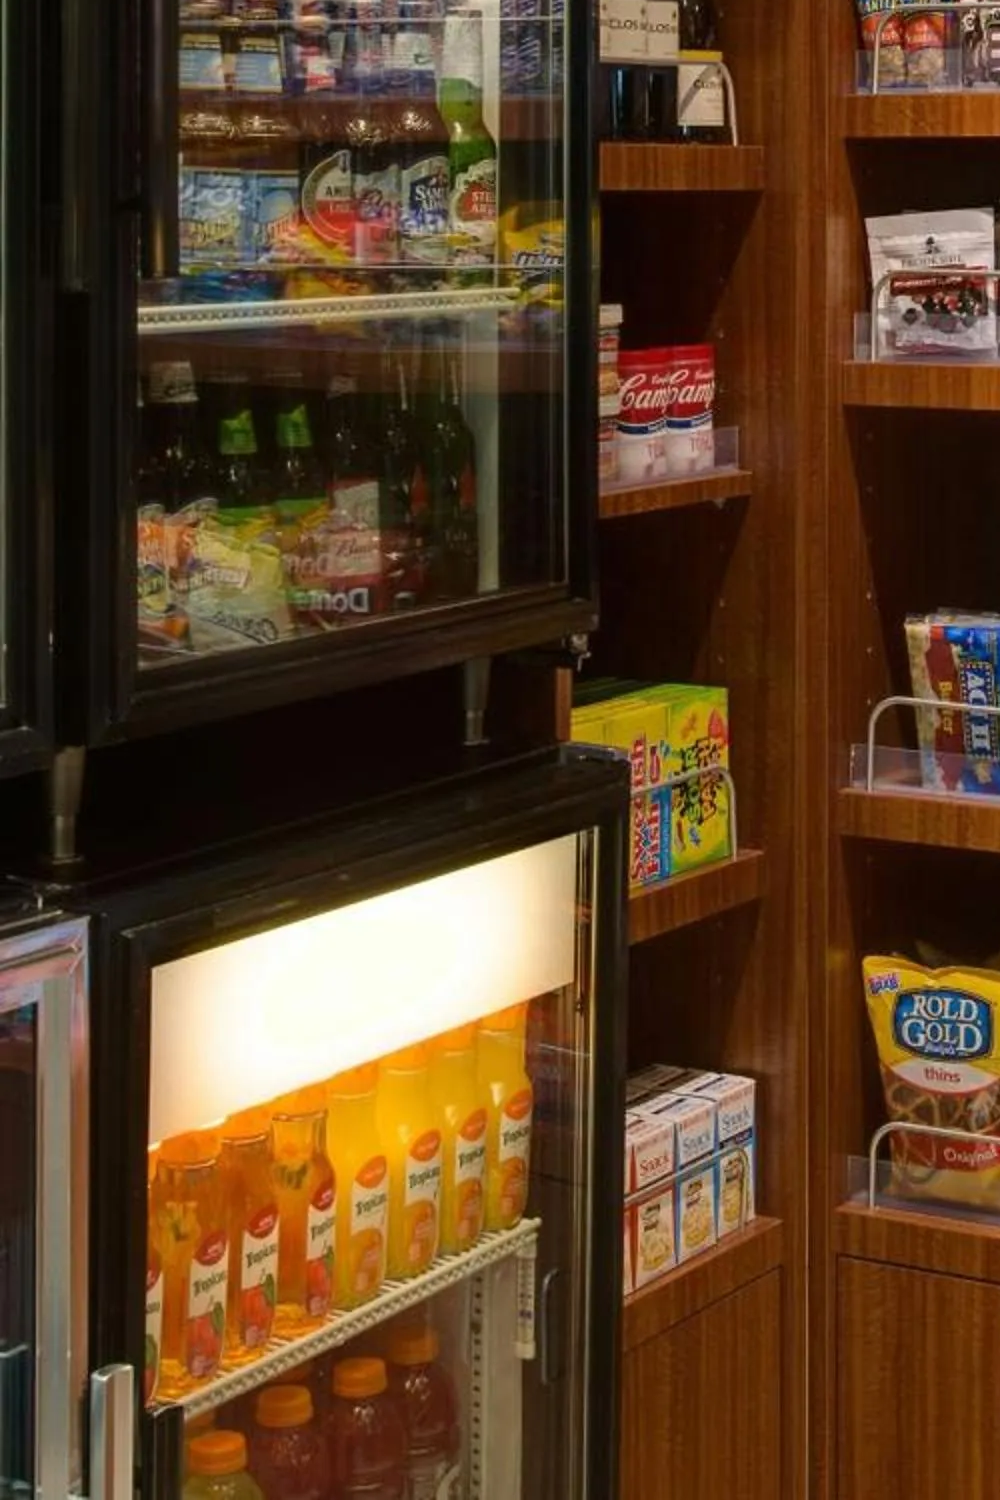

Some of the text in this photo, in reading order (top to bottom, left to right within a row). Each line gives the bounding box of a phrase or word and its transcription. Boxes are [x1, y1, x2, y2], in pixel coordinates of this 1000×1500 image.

[911, 994, 979, 1020] ROLD
[901, 1018, 983, 1053] GOLD
[923, 1066, 961, 1082] thins
